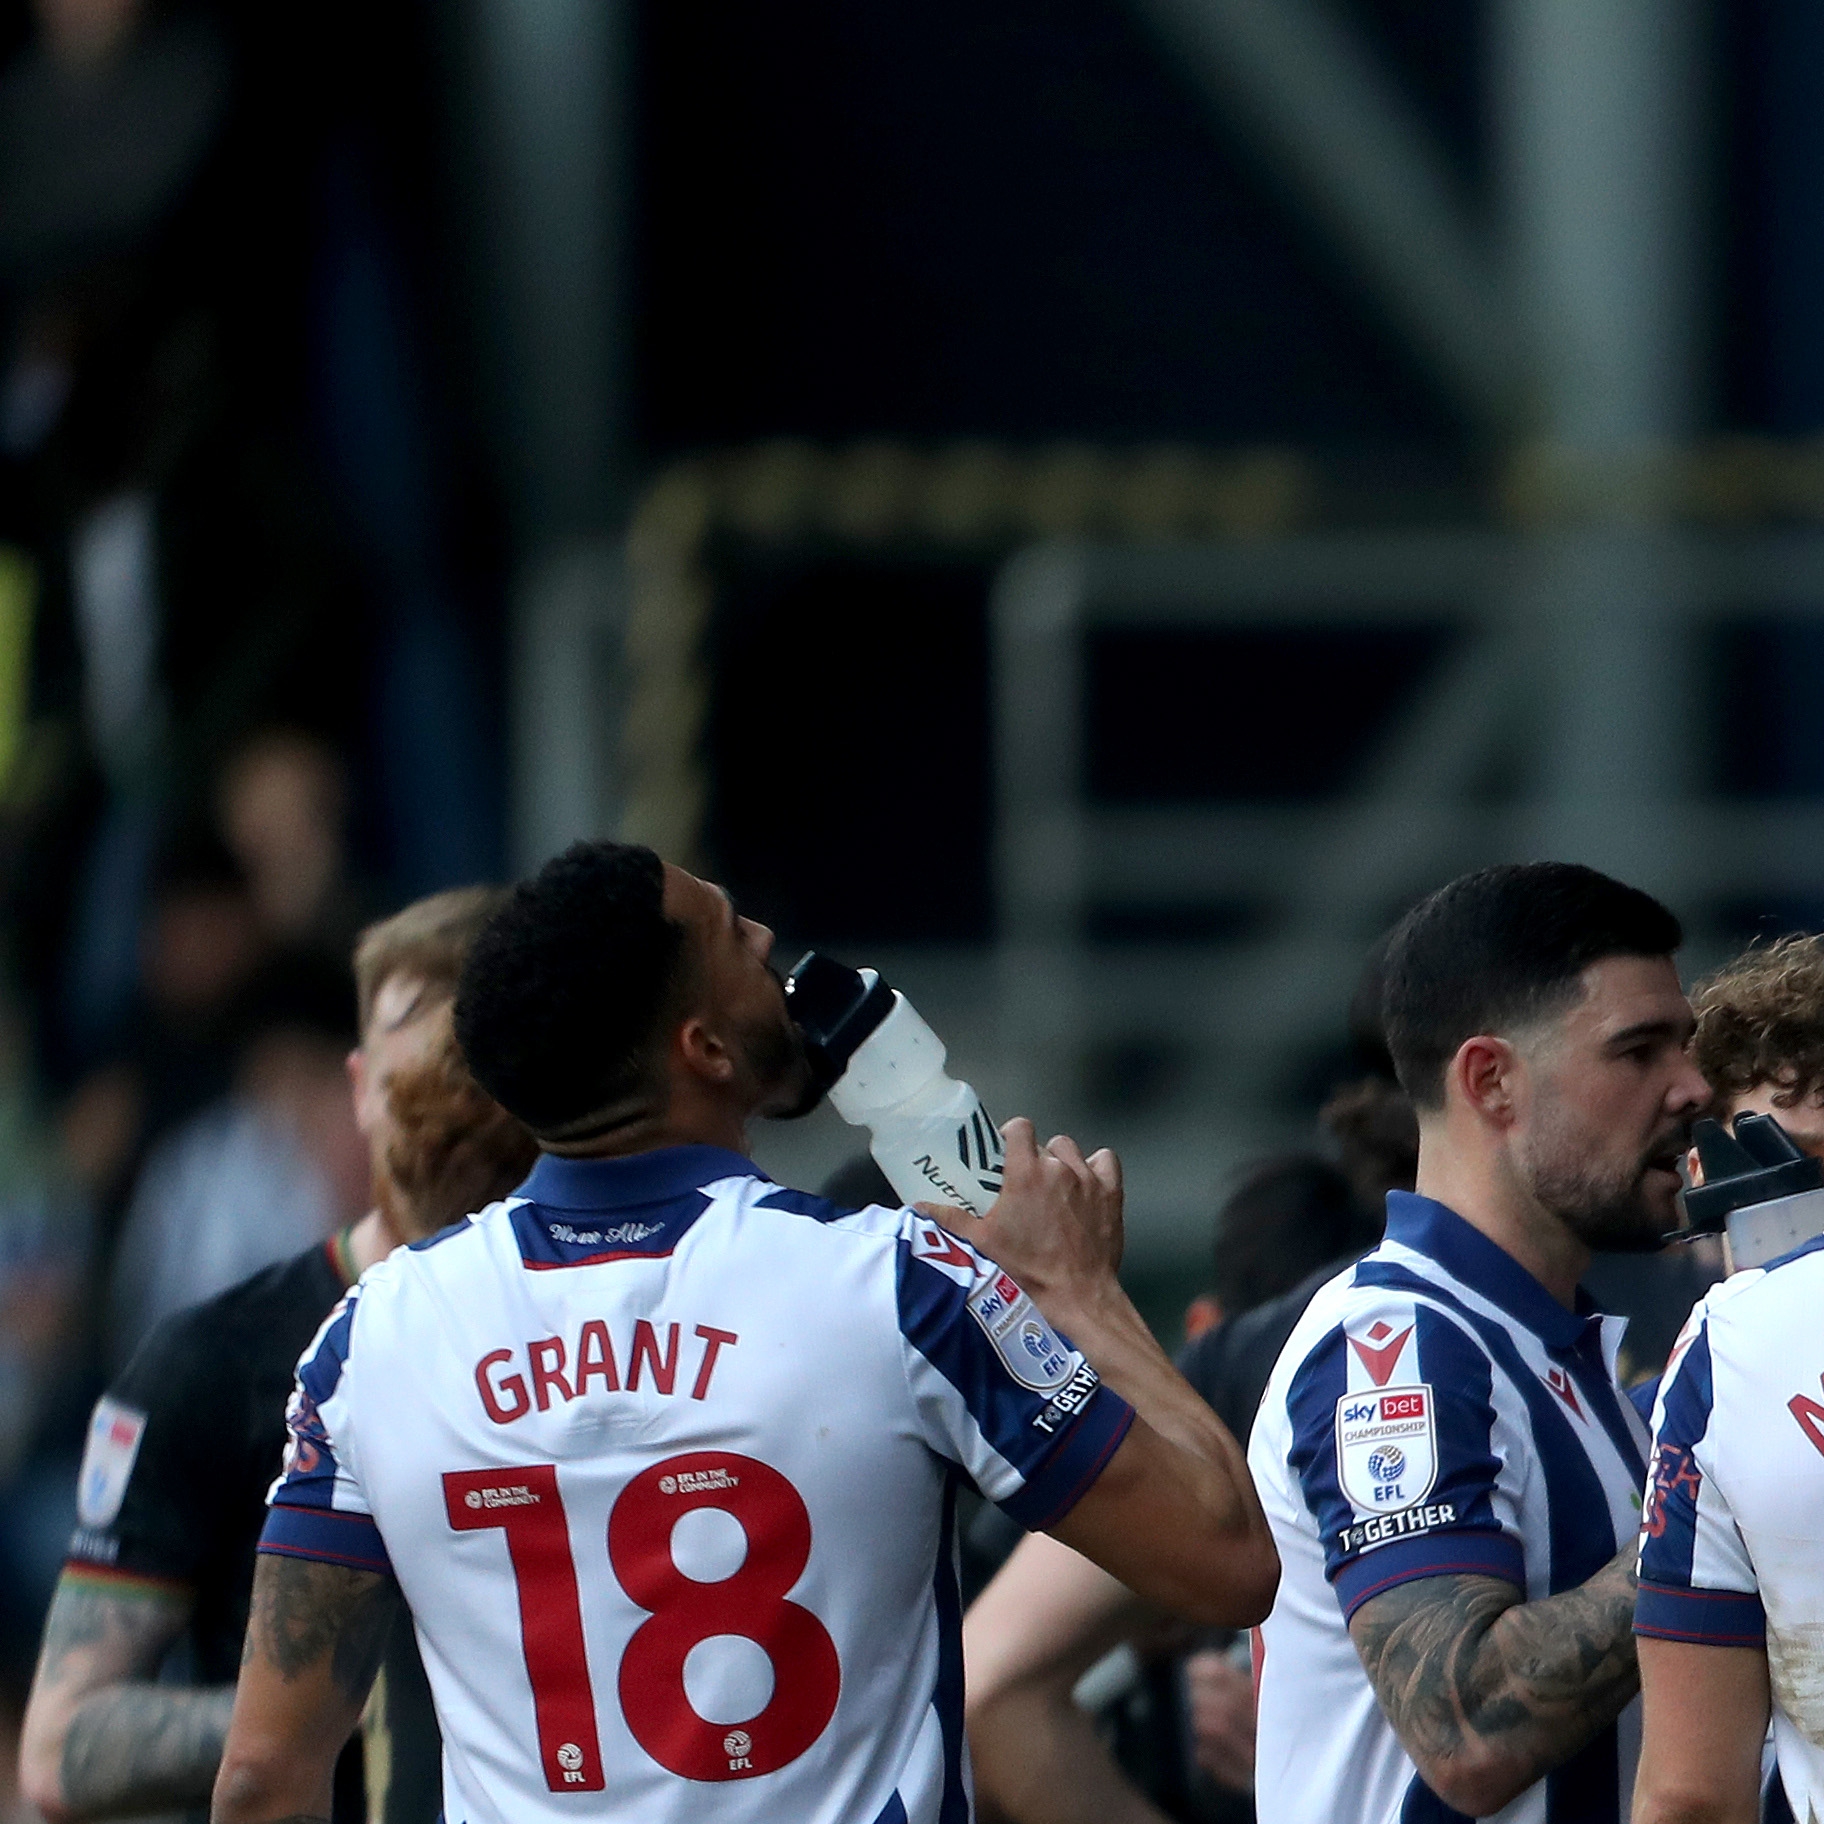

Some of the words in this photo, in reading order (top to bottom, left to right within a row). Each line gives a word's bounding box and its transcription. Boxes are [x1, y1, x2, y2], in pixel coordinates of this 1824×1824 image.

[475, 1318, 739, 1426] GRANT
[1043, 1354, 1066, 1378] EFL
[1344, 1402, 1377, 1422] sky
[1383, 1397, 1420, 1416] bet
[1345, 1421, 1426, 1442] CHAMPIONSHIP
[1374, 1484, 1405, 1501] EFL
[442, 1450, 842, 1793] 18
[728, 1757, 753, 1771] EFL
[562, 1771, 586, 1783] EFL
